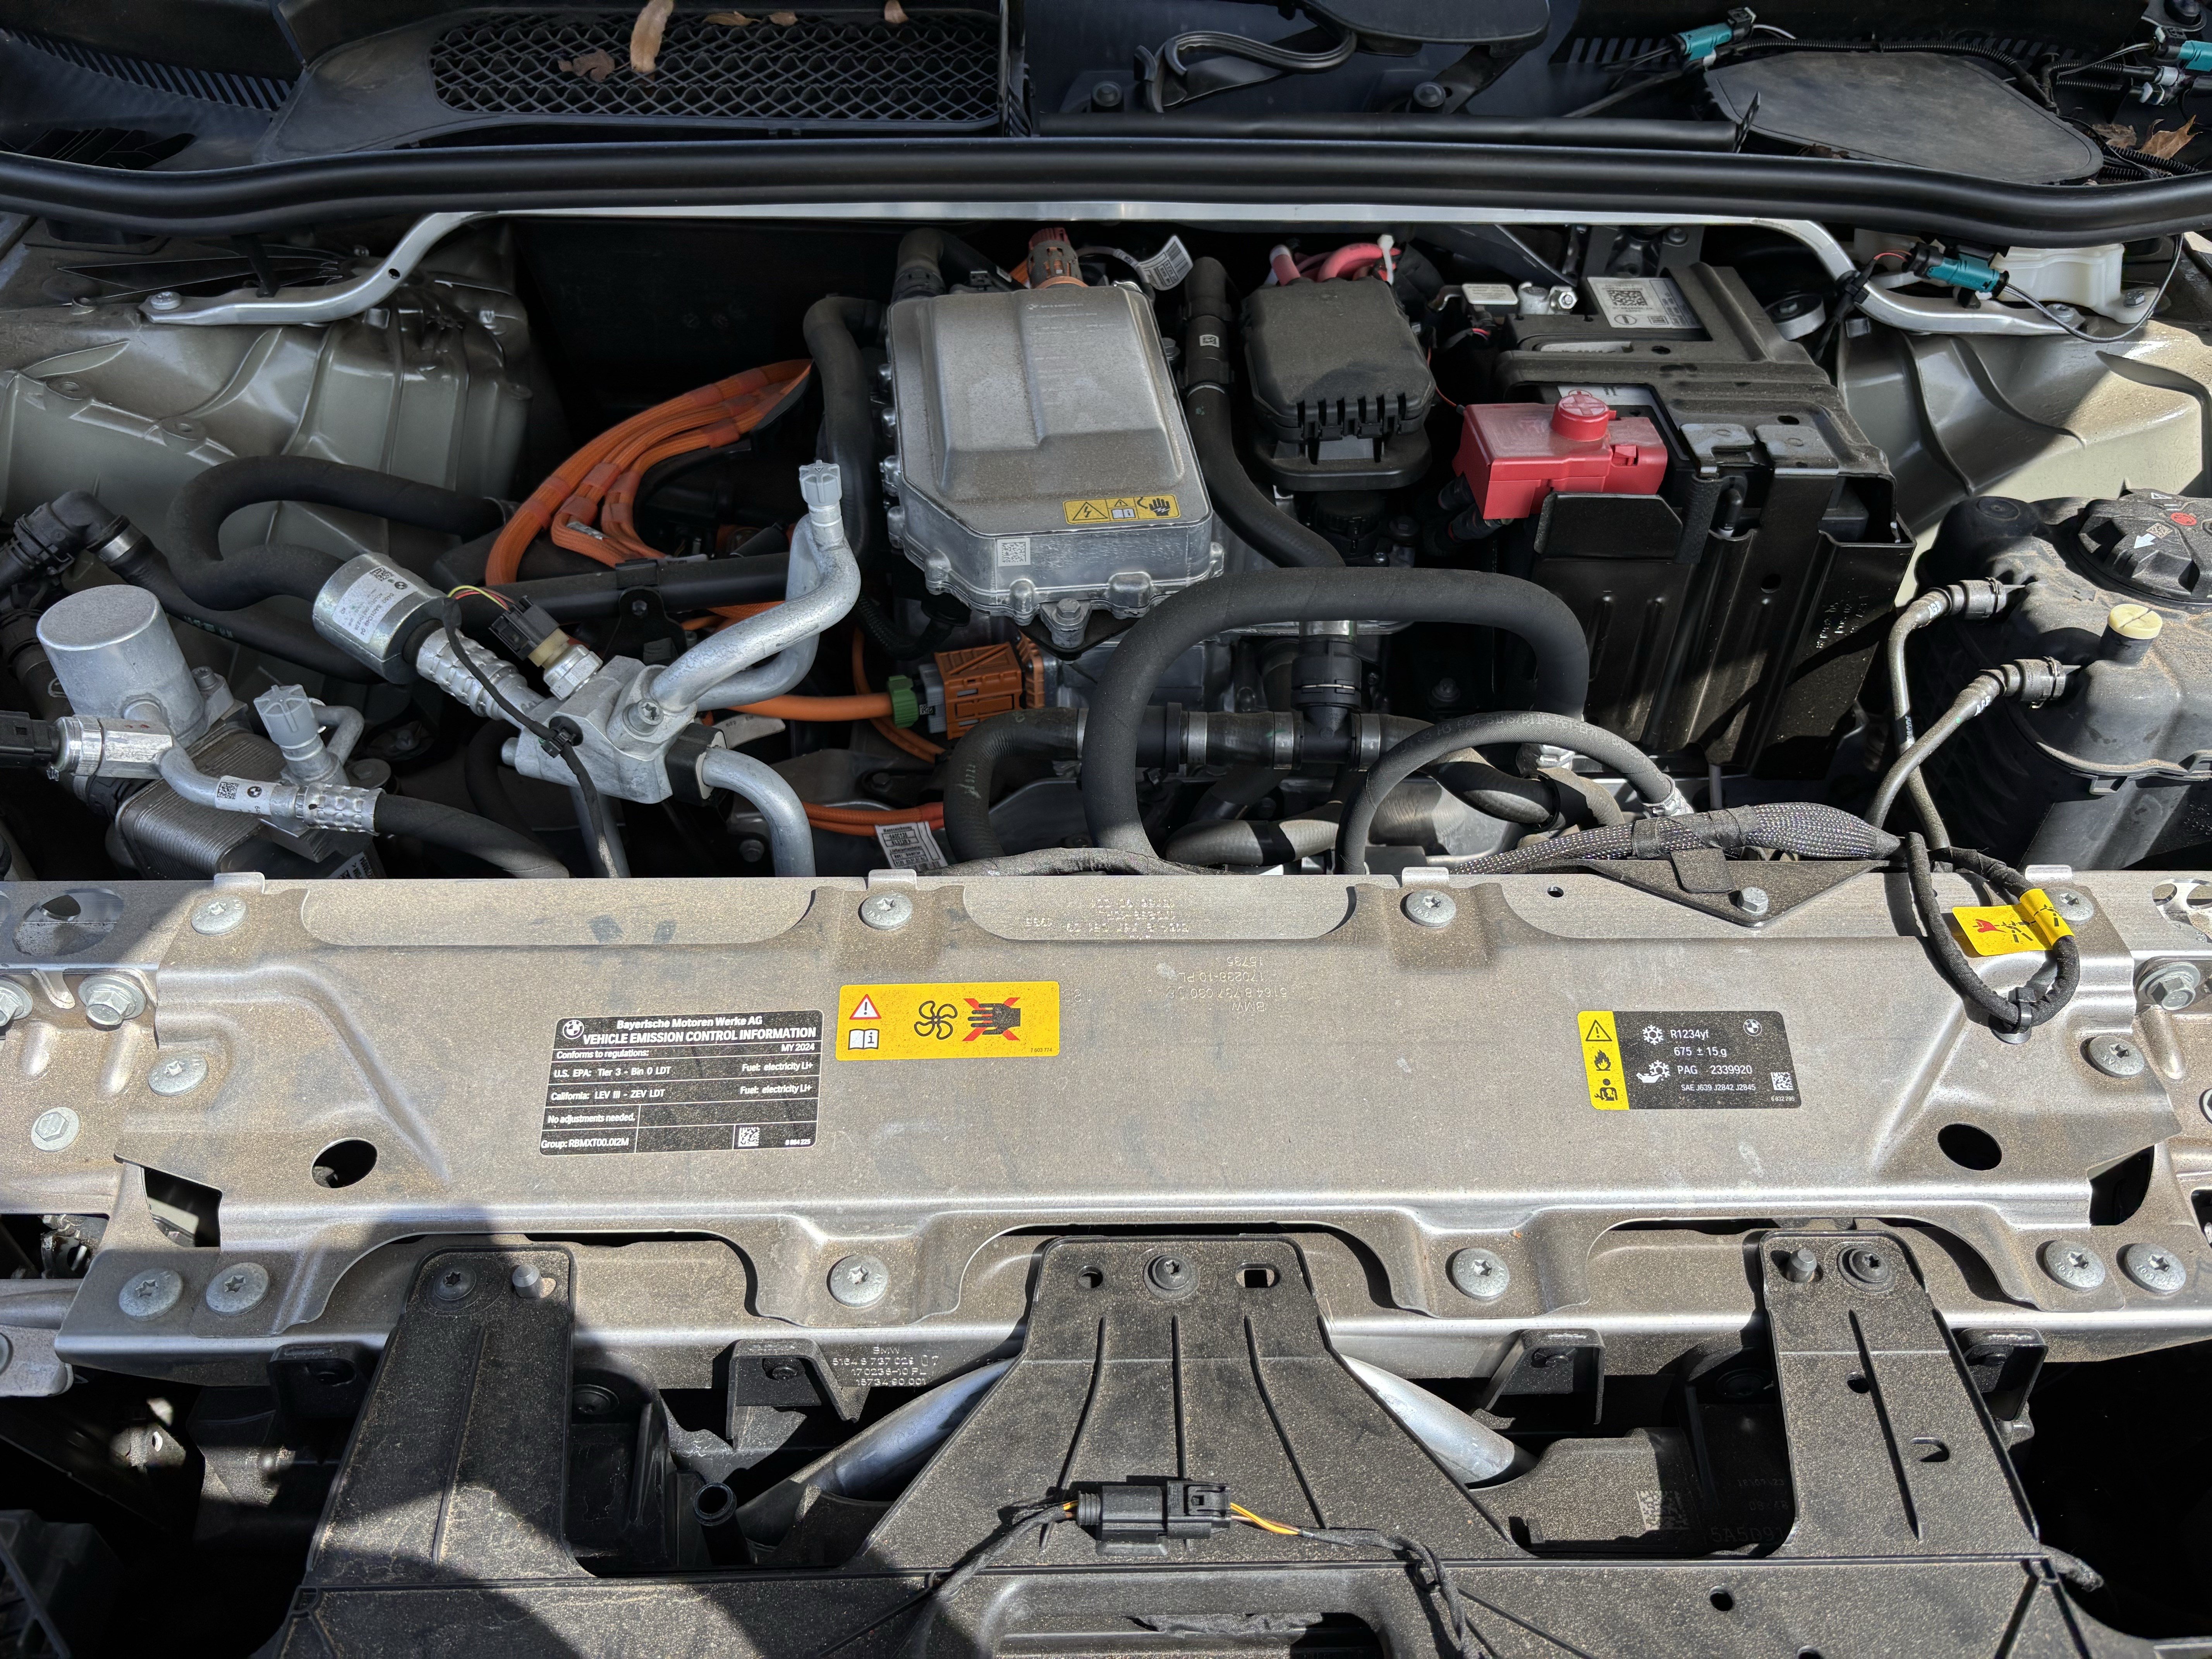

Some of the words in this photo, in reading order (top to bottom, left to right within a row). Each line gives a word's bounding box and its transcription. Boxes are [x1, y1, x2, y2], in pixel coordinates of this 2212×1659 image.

[1178, 972, 1195, 982] PL
[1245, 988, 1252, 998] 8
[1257, 988, 1287, 998] 5164
[1231, 1002, 1264, 1012] BMW
[617, 1018, 669, 1030] Bayerische
[672, 1018, 713, 1027] Motoren
[716, 1017, 746, 1026] Werke
[747, 1016, 762, 1025] AG
[584, 1032, 627, 1045] VEHICLE
[630, 1030, 684, 1044] EMISSION
[686, 1029, 738, 1042] CONTROL
[740, 1027, 816, 1041] INFORMATION
[1670, 1029, 1709, 1040] R1234yf
[795, 1043, 814, 1051] 2024
[1674, 1047, 1692, 1056] 675
[557, 1051, 593, 1059] Conforms
[605, 1049, 649, 1059] regulations:
[554, 1069, 570, 1077] U.S.
[573, 1068, 591, 1077] EPA:
[598, 1068, 612, 1077] Tier
[616, 1068, 620, 1076] 3
[631, 1067, 644, 1075] Bin
[656, 1066, 671, 1074] LDT
[742, 1063, 760, 1072] Fuel:
[764, 1062, 800, 1073] electricity
[802, 1062, 813, 1070] Li+
[1678, 1066, 1697, 1074] PAG
[1710, 1065, 1752, 1074] 2339920
[551, 1091, 589, 1101] California:
[595, 1091, 610, 1099] LEV
[630, 1089, 647, 1098] ZEV
[649, 1089, 665, 1097] LDT
[740, 1086, 759, 1094] Fuel:
[762, 1085, 799, 1096] electricity
[800, 1085, 812, 1093] Li+
[548, 1115, 558, 1123] No
[560, 1114, 604, 1125] adjustments
[606, 1113, 635, 1122] needed.
[541, 1139, 568, 1149] Group:
[2055, 1262, 2073, 1278] 10.9
[2137, 1265, 2154, 1281] 10.9
[870, 1357, 891, 1365] 737
[911, 1367, 927, 1376] PL
